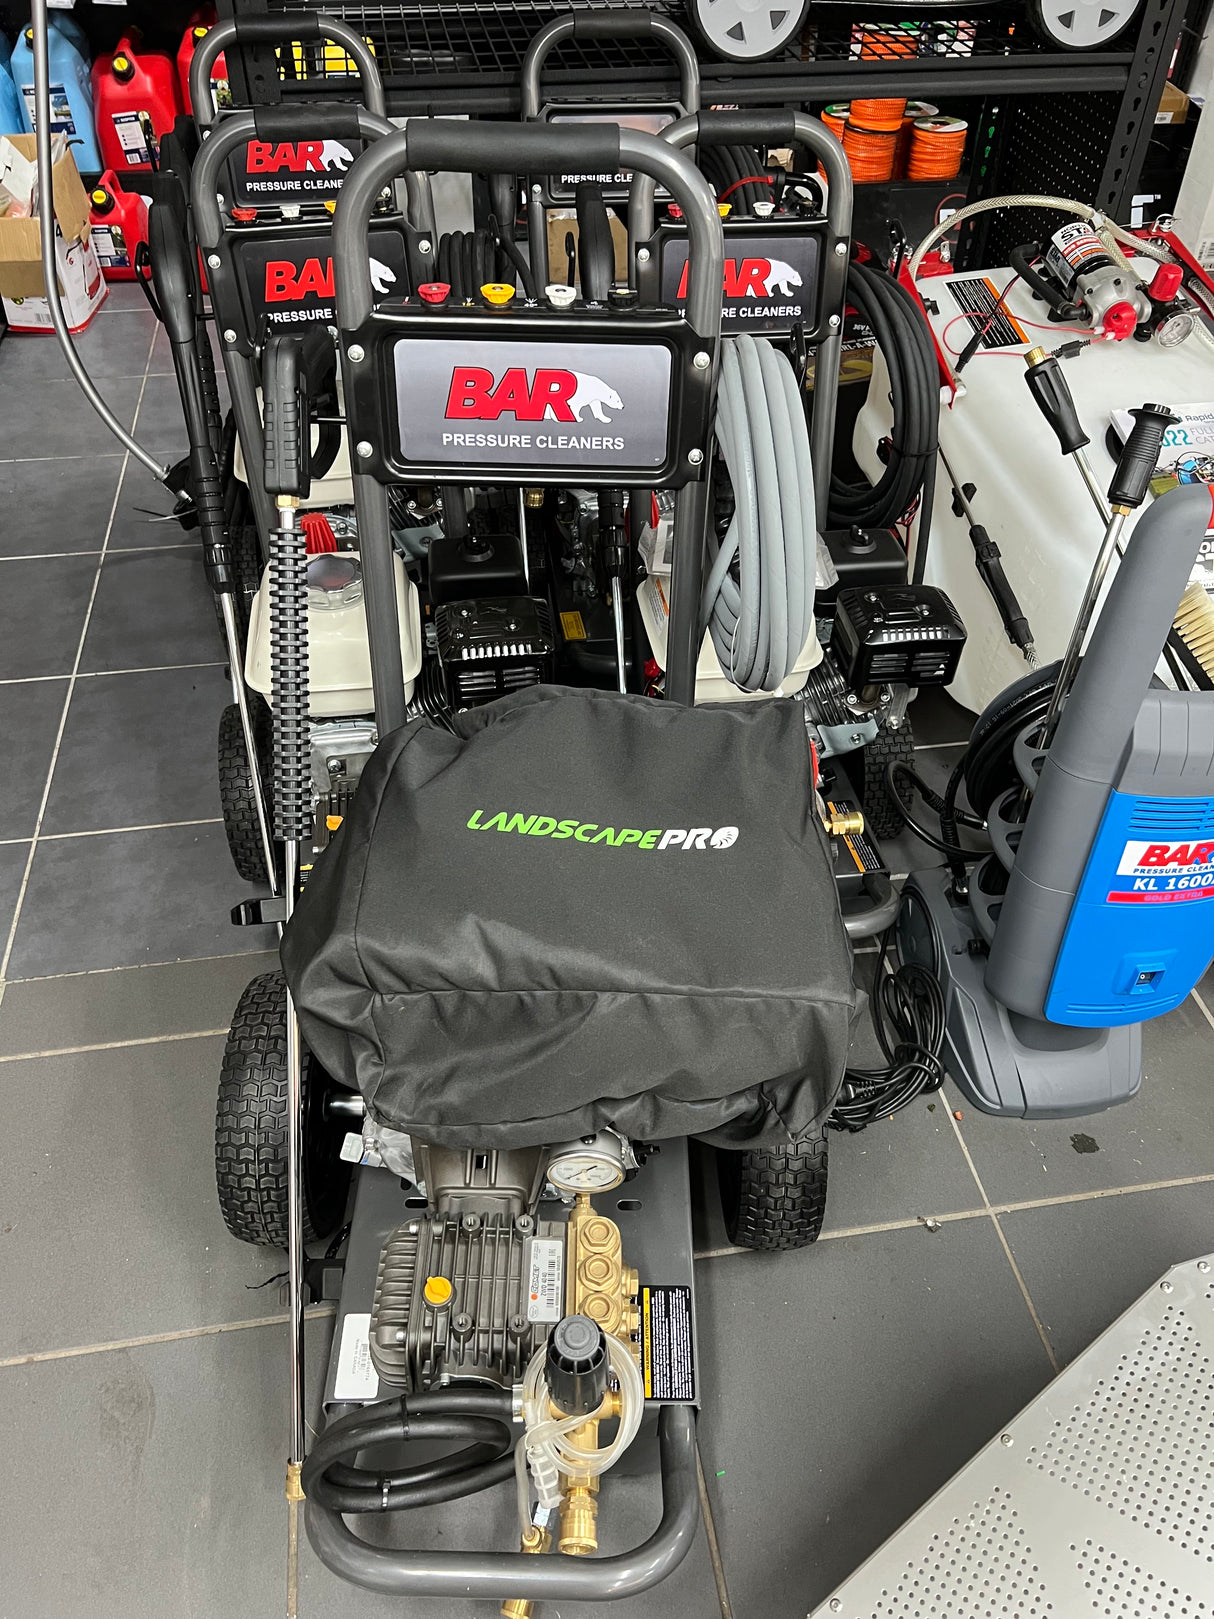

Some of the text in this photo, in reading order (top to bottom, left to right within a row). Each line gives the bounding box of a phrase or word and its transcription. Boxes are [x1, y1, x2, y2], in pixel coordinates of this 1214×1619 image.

[247, 138, 326, 174] BAR
[246, 179, 344, 192] PRESSURE CLEANE
[265, 257, 336, 303] BA
[738, 305, 802, 318] CLEANERS
[444, 366, 579, 423] BAR
[1185, 412, 1214, 422] Rapid
[442, 433, 625, 450] PRESSURE CLEANERS
[1137, 842, 1214, 866] BAR
[1186, 865, 1214, 873] CLEAN
[1132, 873, 1214, 891] KL 1600
[1143, 890, 1204, 902] GOLD EXTRA
